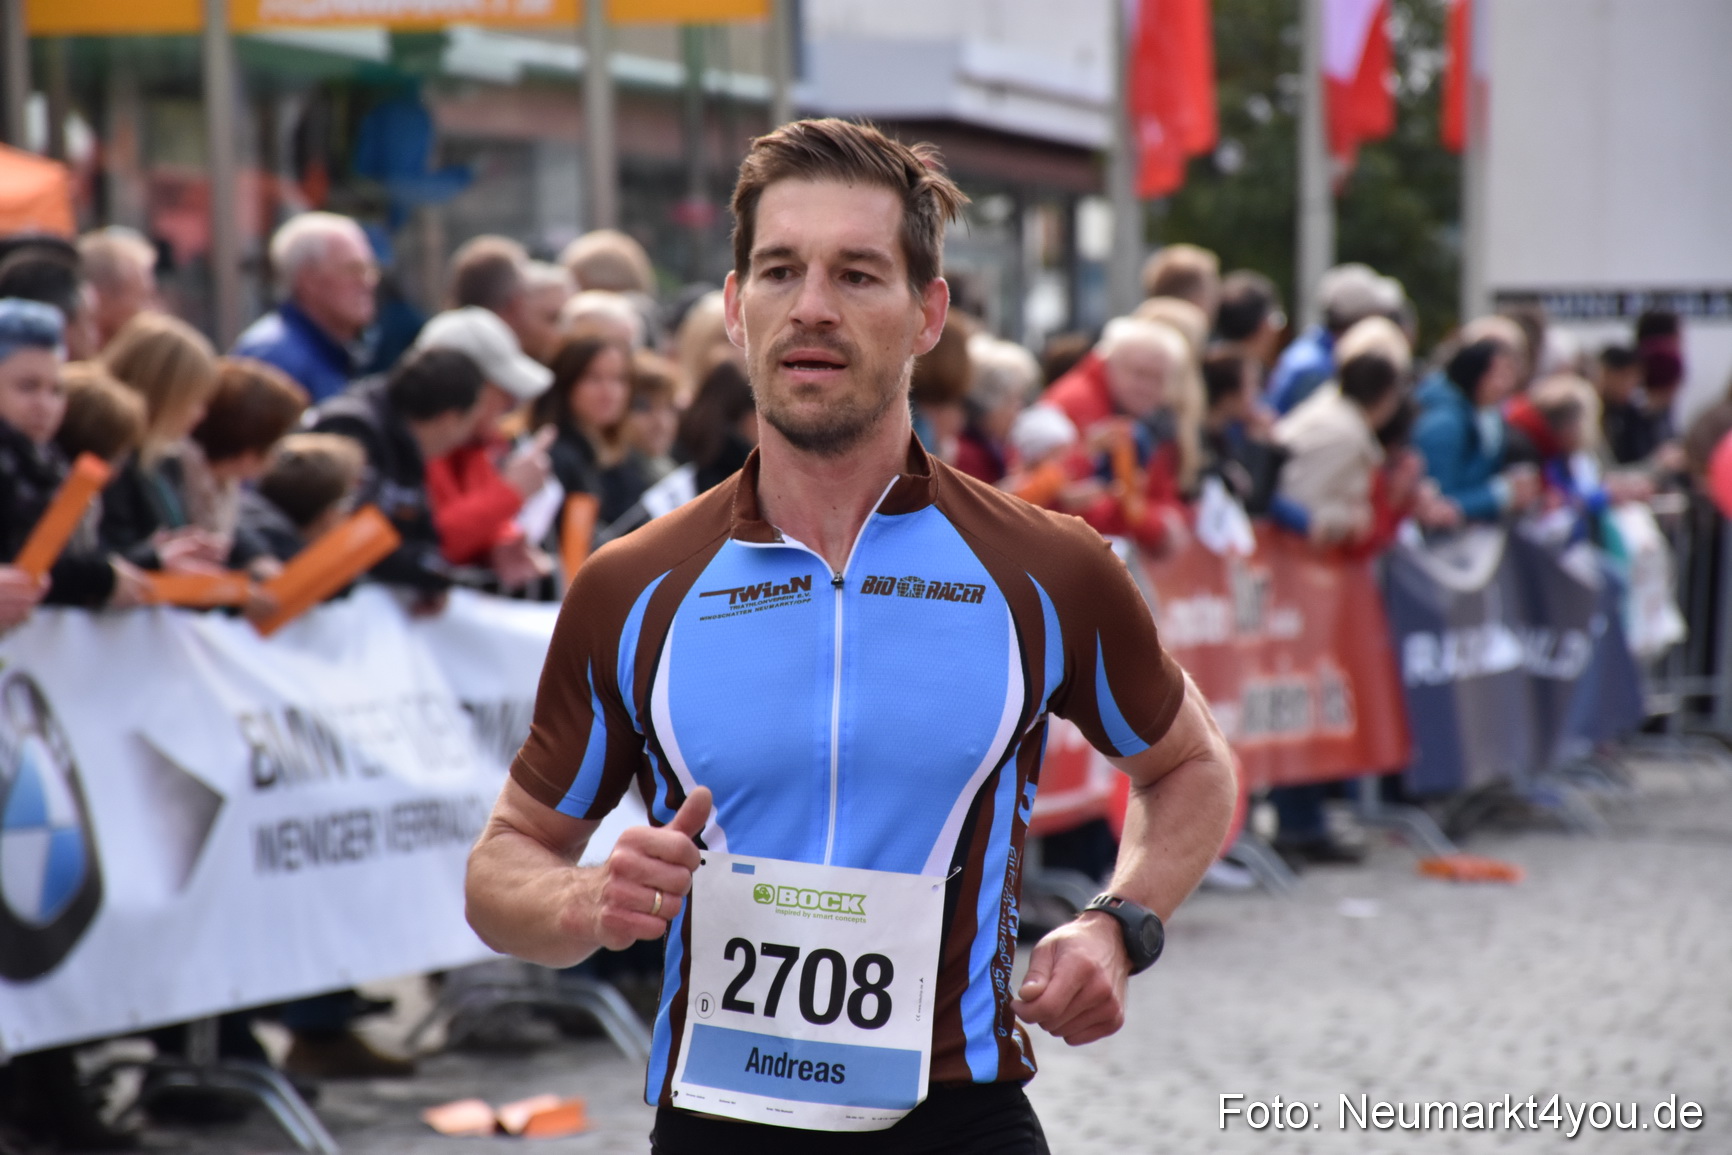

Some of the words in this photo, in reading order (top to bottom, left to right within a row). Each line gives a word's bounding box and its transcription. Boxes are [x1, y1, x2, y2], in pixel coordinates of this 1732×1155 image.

[925, 580, 986, 604] RACER
[776, 885, 867, 916] BOCK
[775, 907, 801, 918] inspired
[802, 909, 811, 919] by
[812, 912, 833, 921] smart
[834, 915, 867, 924] concepts
[721, 937, 895, 1030] 2708
[701, 998, 709, 1013] D
[745, 1046, 846, 1085] Andreas
